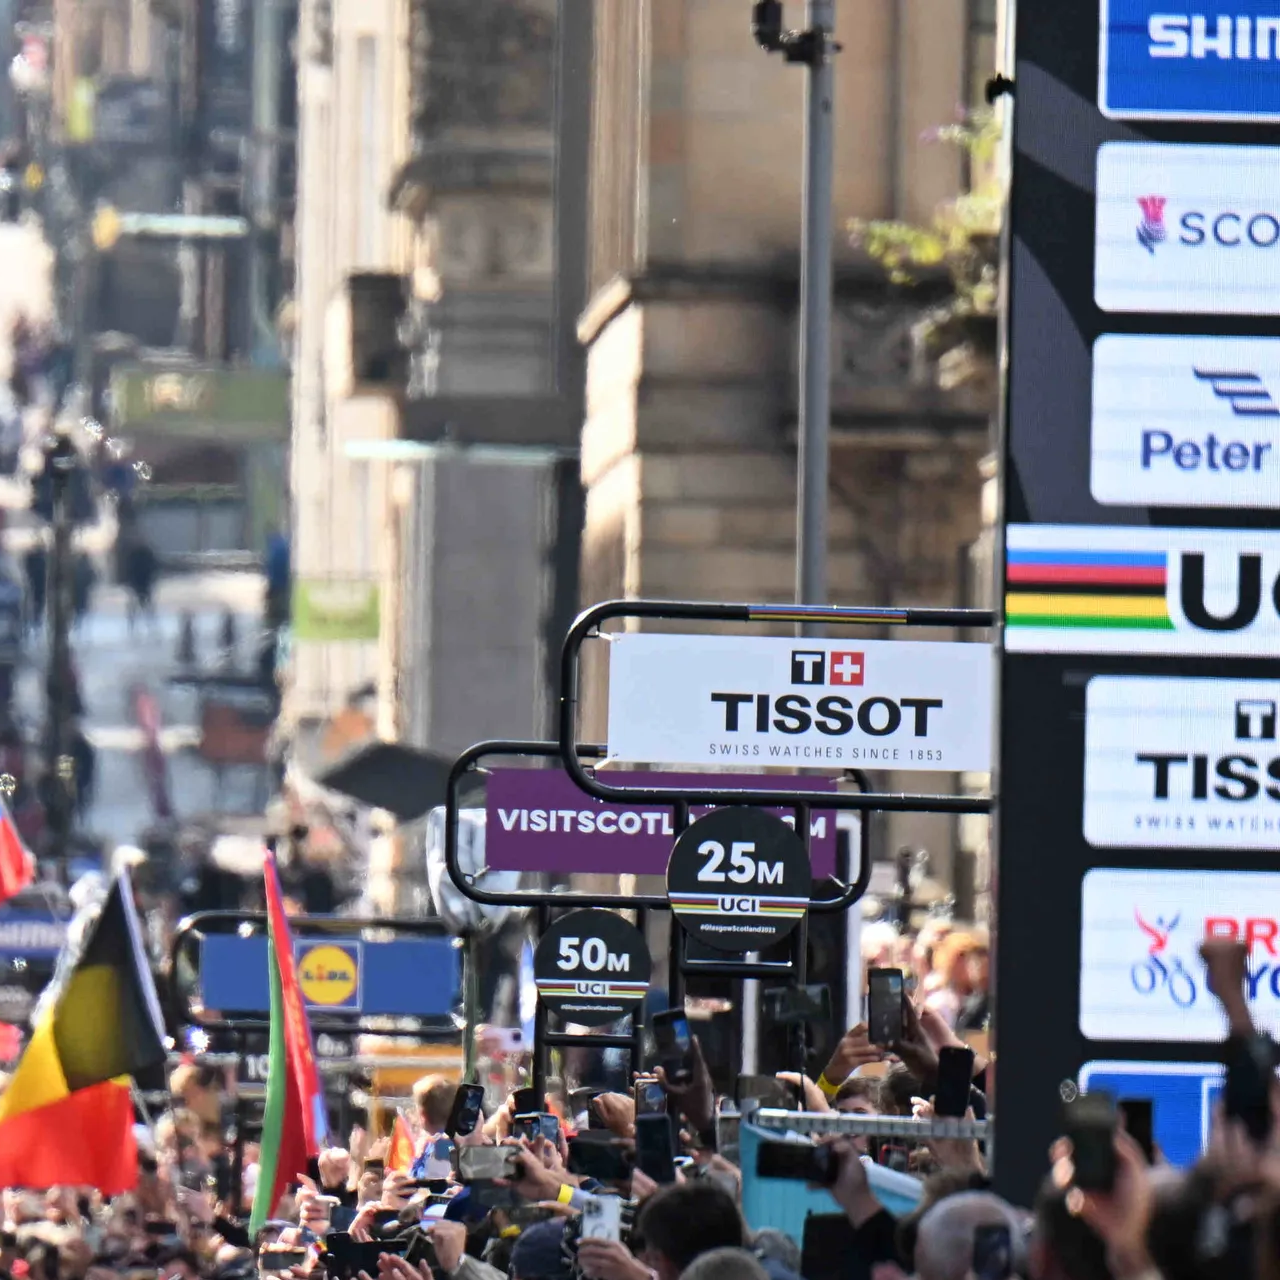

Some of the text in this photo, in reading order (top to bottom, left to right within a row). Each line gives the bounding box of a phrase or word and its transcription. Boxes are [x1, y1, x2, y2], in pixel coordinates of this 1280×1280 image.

[1180, 211, 1280, 247] SCO
[1141, 429, 1272, 471] Peter
[1180, 551, 1280, 630] U
[710, 692, 944, 737] TISSOT
[709, 744, 943, 761] SWISS WATCHES SINCE 1853
[497, 808, 827, 839] VISITSCOTLM
[697, 840, 784, 885] 25M
[720, 898, 756, 913] UCI
[556, 937, 630, 972] 50M
[577, 983, 606, 995] UCI
